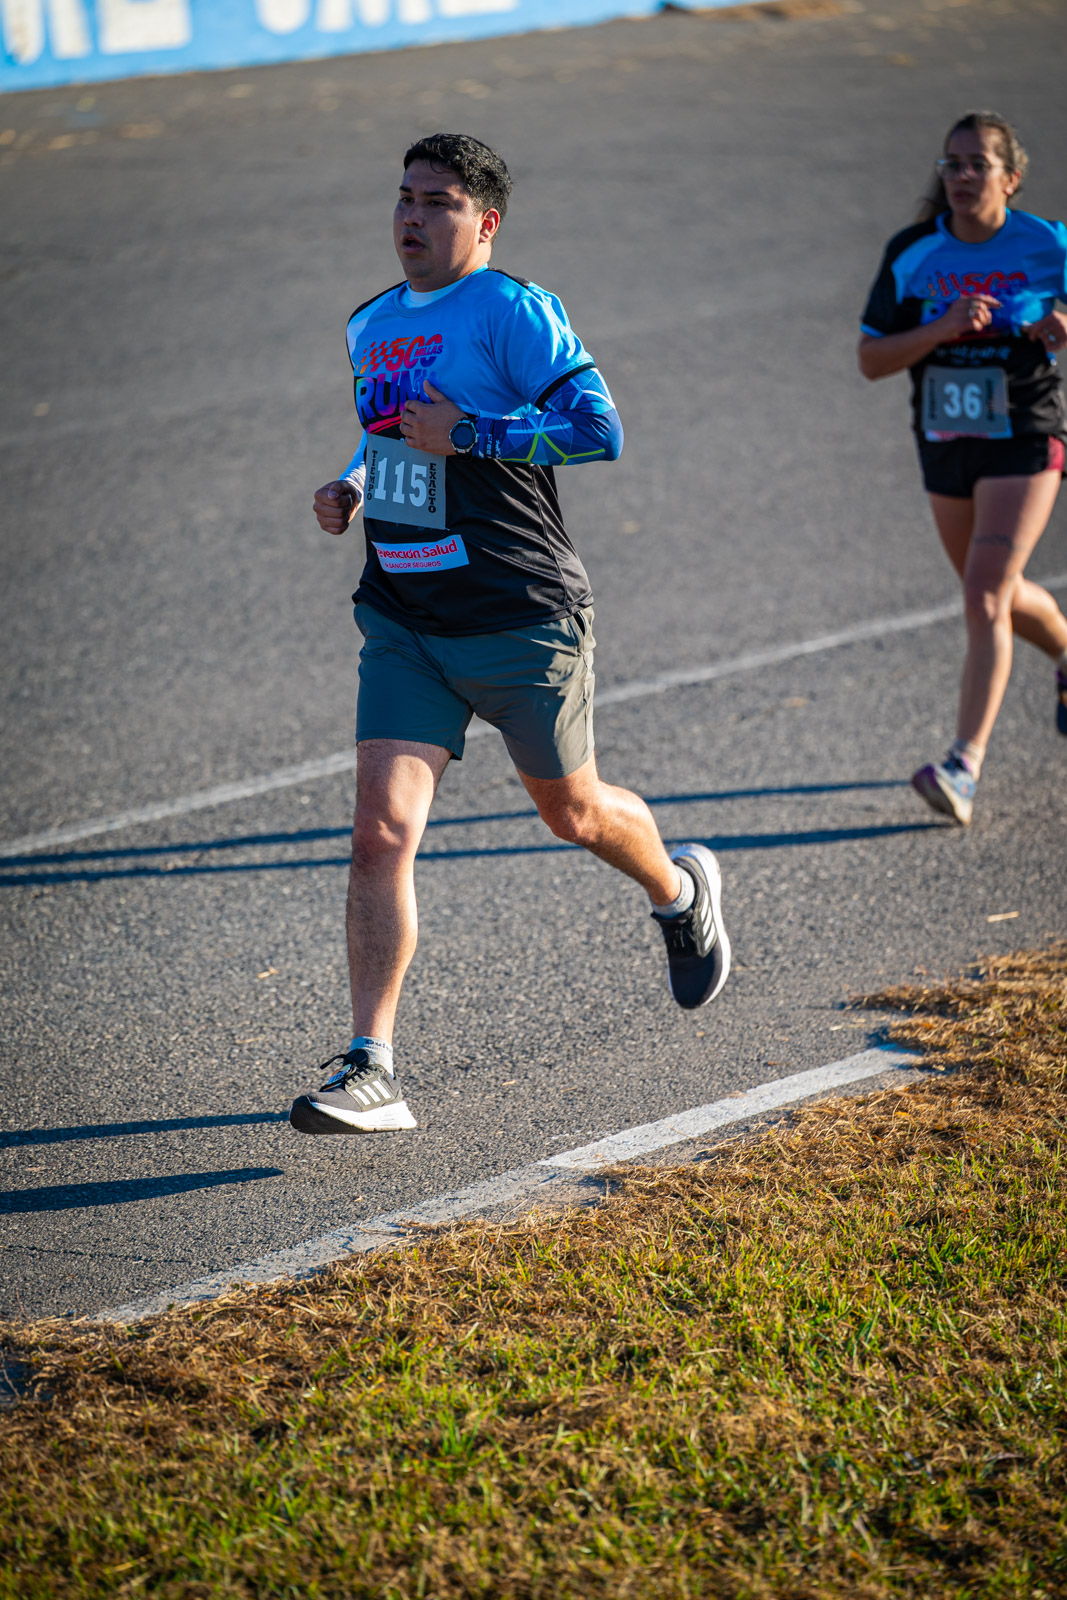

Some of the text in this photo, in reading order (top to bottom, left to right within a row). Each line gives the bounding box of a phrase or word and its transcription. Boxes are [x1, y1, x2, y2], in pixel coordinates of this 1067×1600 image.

[414, 345, 443, 357] MILLAS
[943, 382, 982, 419] 36
[366, 450, 378, 501] TIEMPO
[374, 457, 427, 507] 115
[428, 463, 437, 513] EXACTO
[412, 560, 442, 568] SEGUROS
[422, 539, 458, 558] Salud
